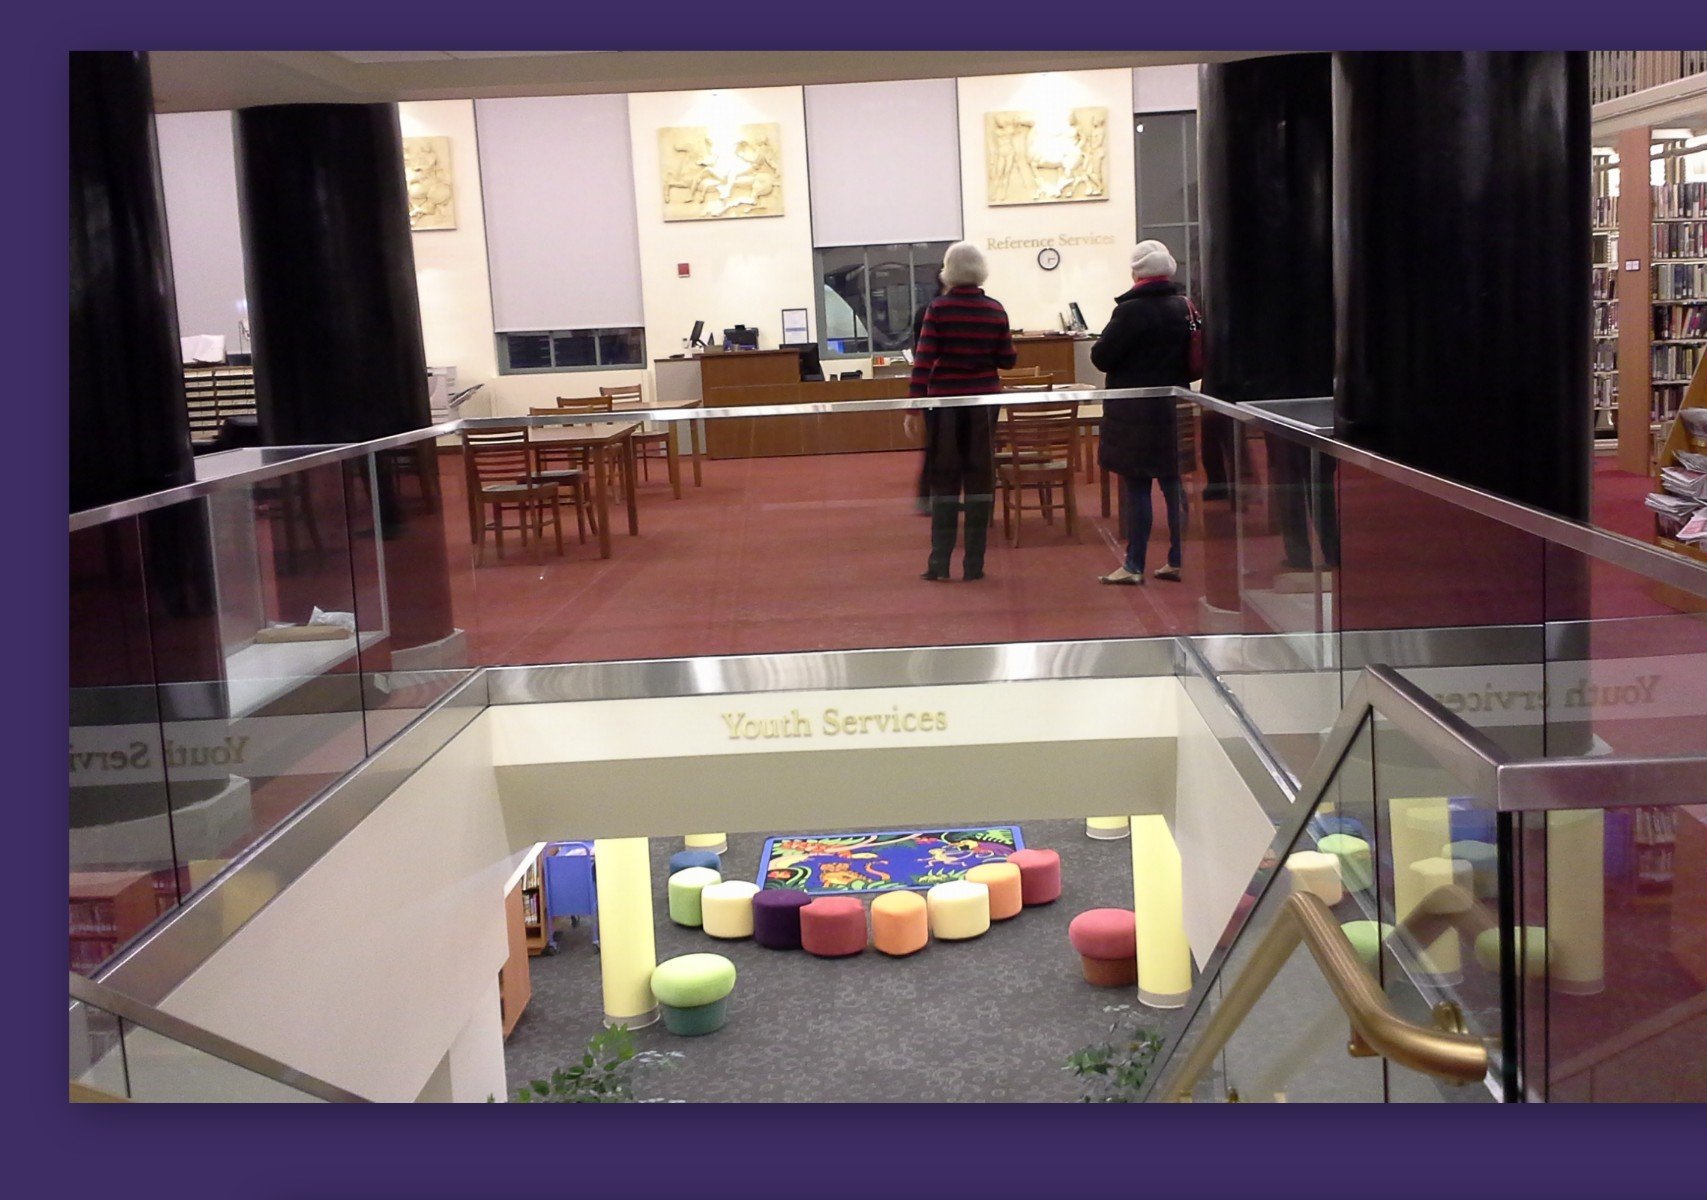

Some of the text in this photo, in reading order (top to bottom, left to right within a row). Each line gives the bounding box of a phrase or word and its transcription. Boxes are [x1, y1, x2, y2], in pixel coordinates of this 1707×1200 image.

[985, 231, 1116, 251] Reference Services
[721, 704, 949, 740] Youth Services
